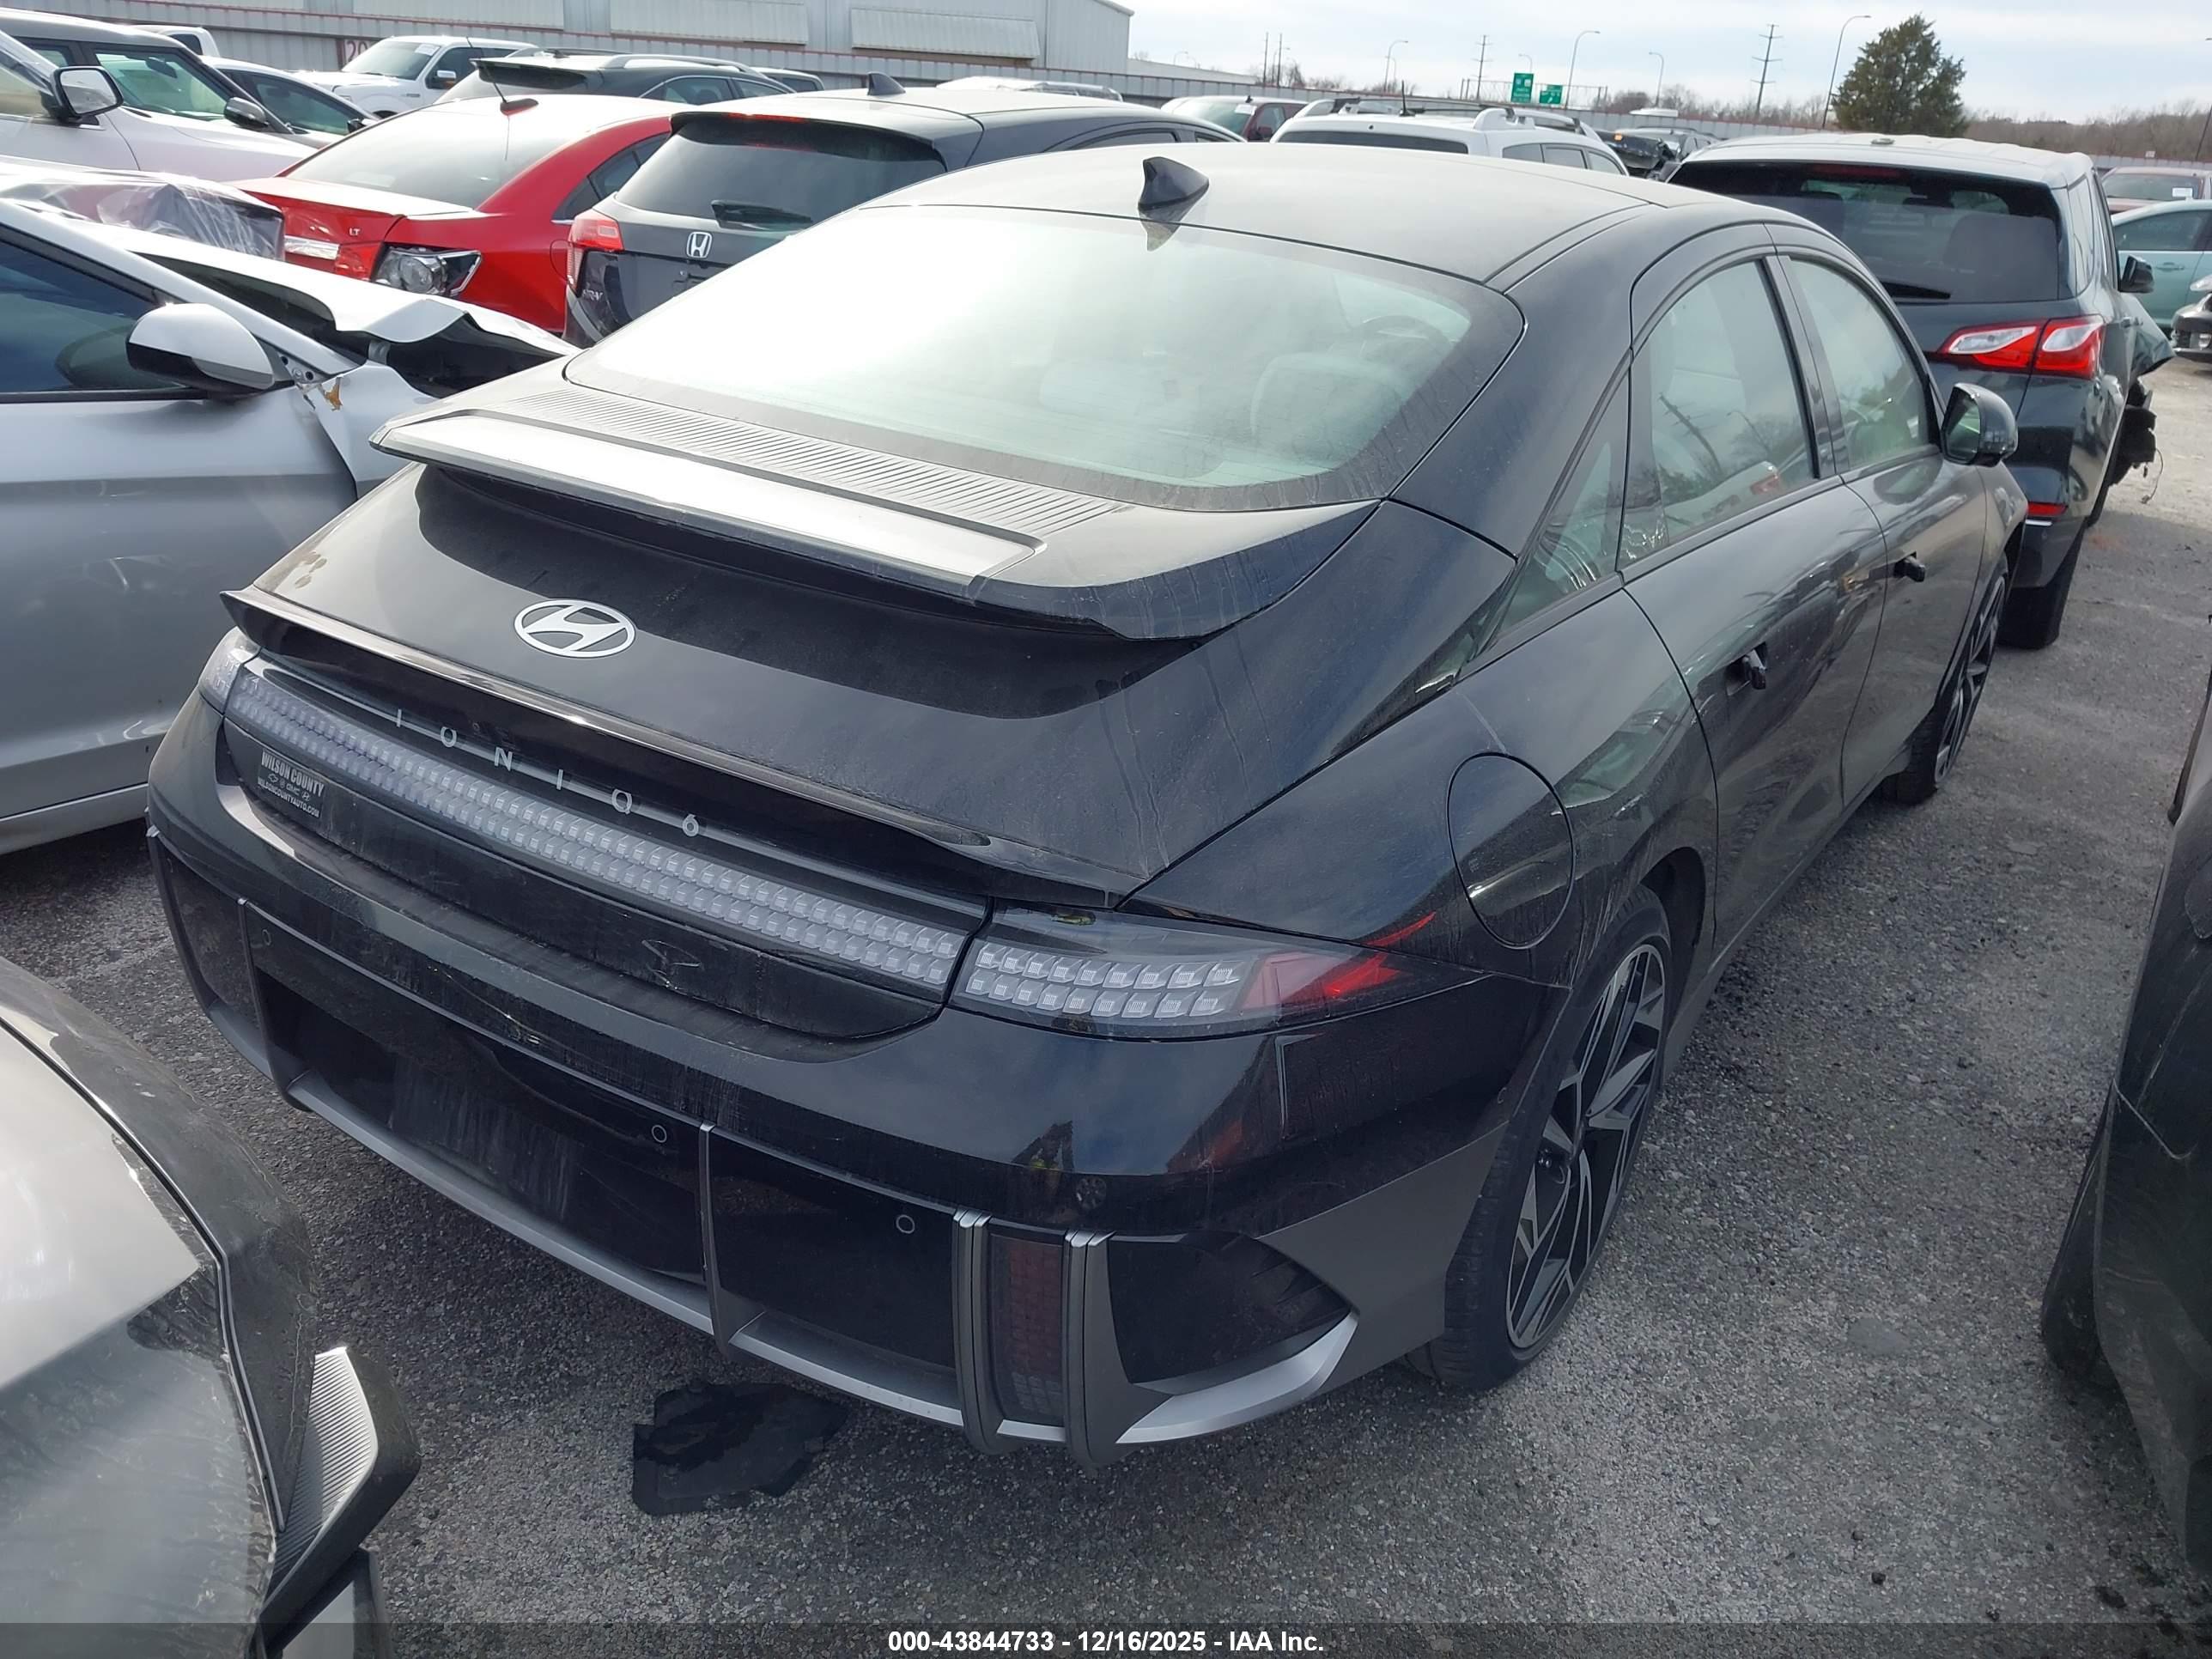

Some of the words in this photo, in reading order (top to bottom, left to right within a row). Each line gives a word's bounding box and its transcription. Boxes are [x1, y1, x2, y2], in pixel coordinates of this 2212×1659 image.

[349, 228, 361, 236] LT
[261, 751, 290, 780] WILSON
[291, 769, 325, 797] COUNTY
[396, 708, 633, 815] IONIQ
[681, 813, 700, 838] 6
[257, 776, 320, 817] WILSONCOUNTYAUTO.COM
